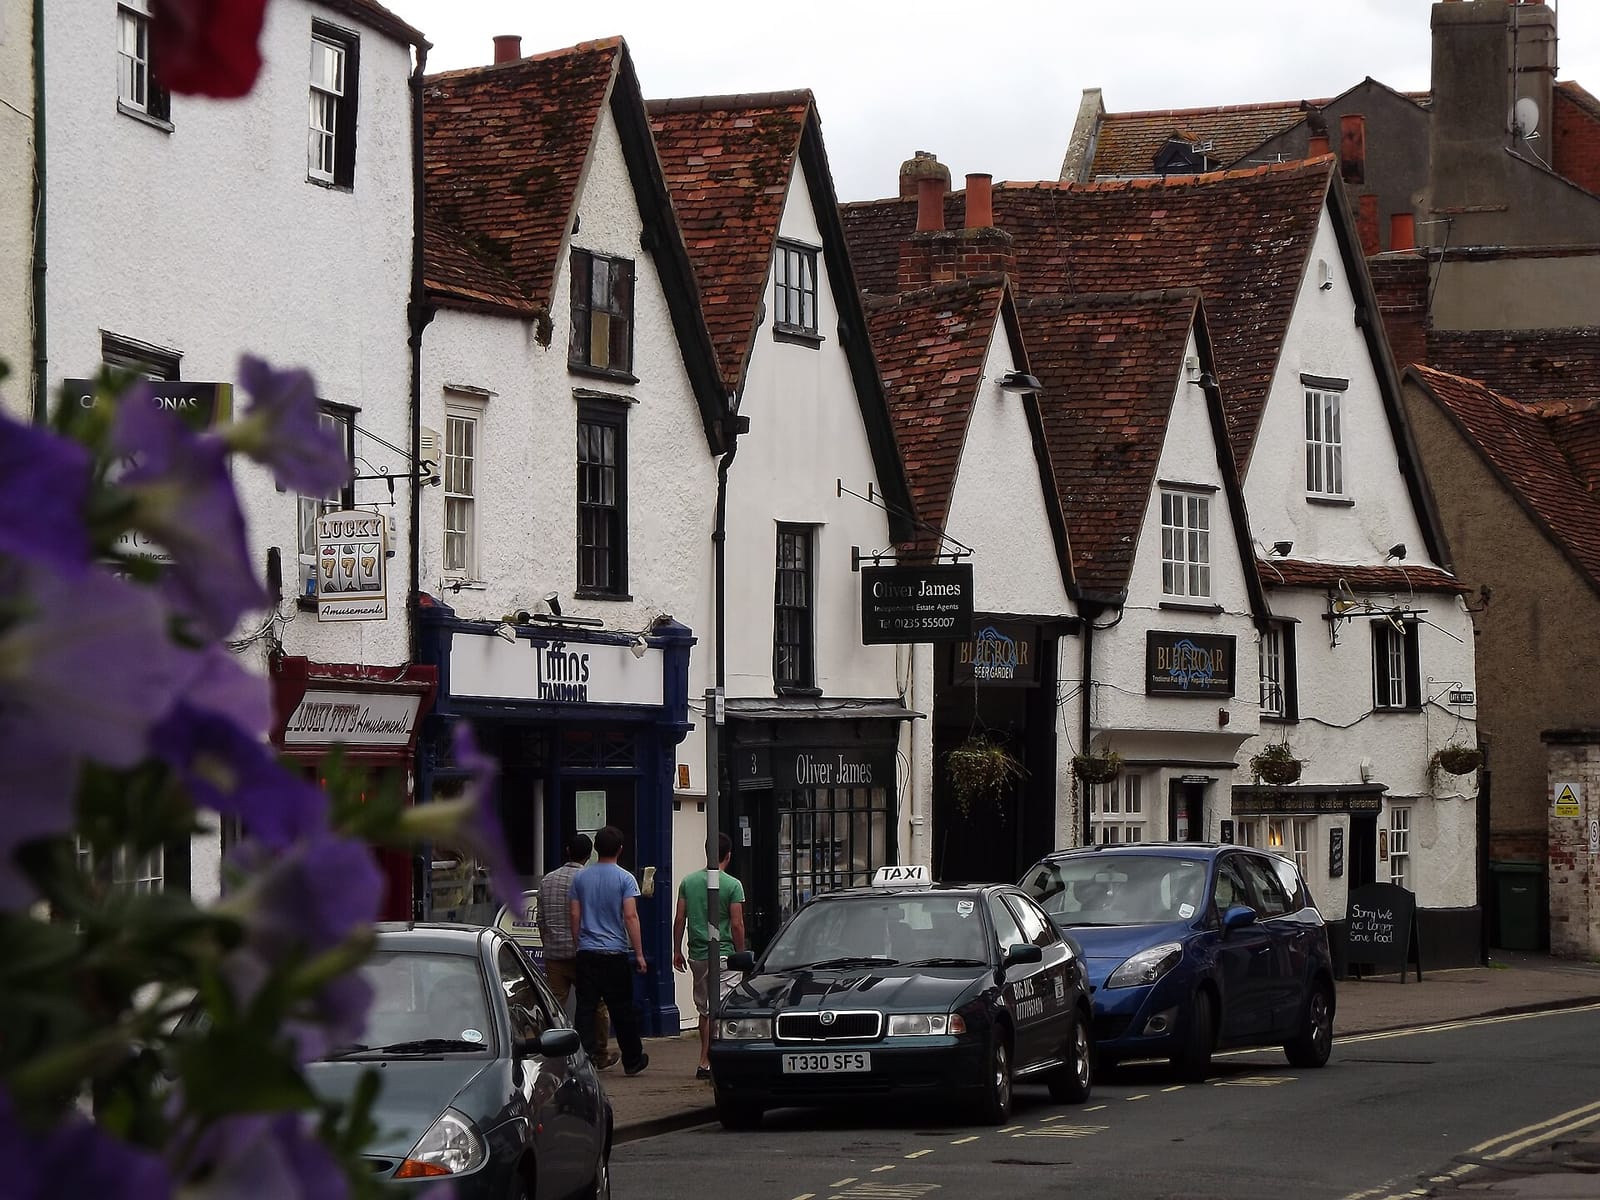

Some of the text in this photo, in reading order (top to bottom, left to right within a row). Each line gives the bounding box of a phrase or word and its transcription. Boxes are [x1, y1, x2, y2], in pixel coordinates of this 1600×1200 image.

[319, 520, 381, 538] LUCKY
[873, 580, 961, 598] Oliver James
[321, 604, 384, 616] Amusements
[916, 603, 935, 611] Estate
[937, 603, 959, 612] Agents
[895, 618, 920, 629] 01235
[922, 617, 955, 628] 555007
[960, 640, 1029, 665] BLUE BOAR
[1157, 646, 1224, 672] BLUE BOAR
[974, 666, 1014, 679] BEER GARDEN
[541, 682, 588, 701] TANDOORI
[356, 705, 408, 734] Amusements
[751, 753, 758, 775] 3
[796, 753, 872, 785] Oliver James
[1350, 798, 1379, 809] Entertainment
[882, 868, 922, 880] TAXI
[1352, 904, 1393, 922] Sorry We
[1013, 982, 1024, 1000] BIG
[789, 1054, 864, 1071] T330 SFS
